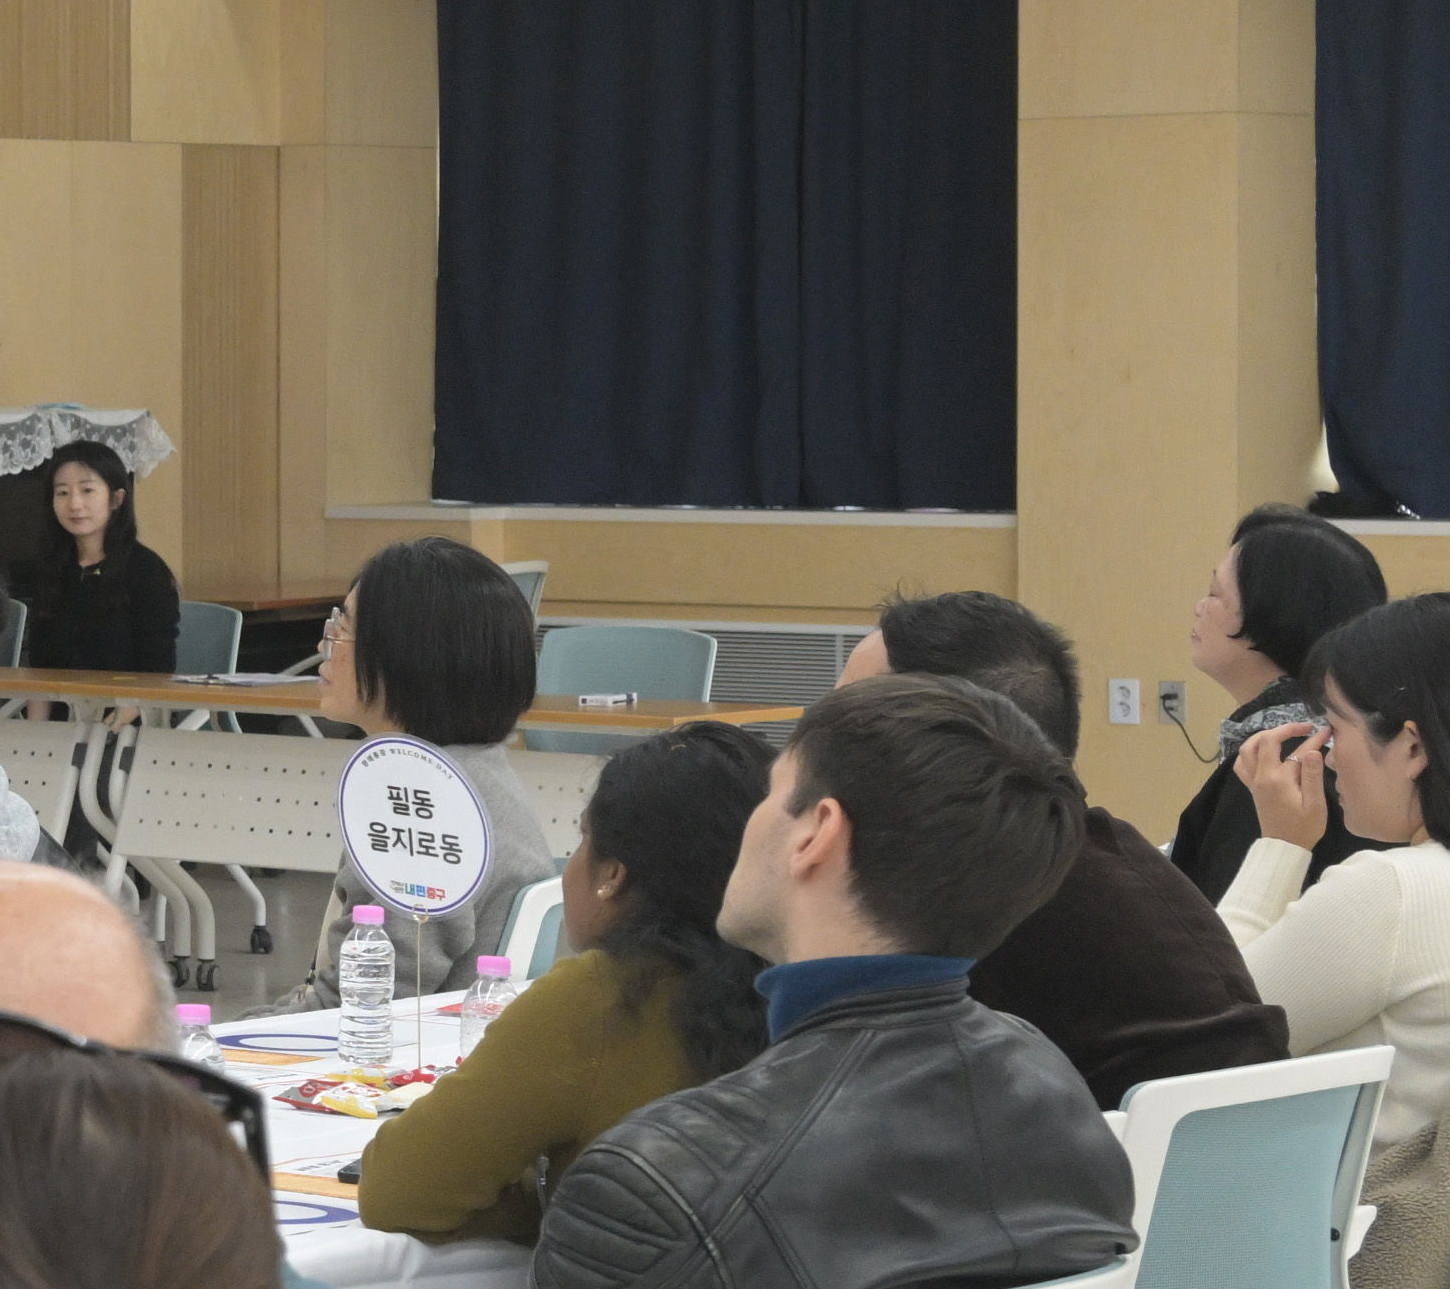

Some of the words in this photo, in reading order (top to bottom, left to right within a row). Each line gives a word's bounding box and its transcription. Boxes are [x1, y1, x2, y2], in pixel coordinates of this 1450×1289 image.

[435, 763, 454, 780] DAY
[387, 785, 435, 820] 필동
[367, 821, 463, 865] 을지로동
